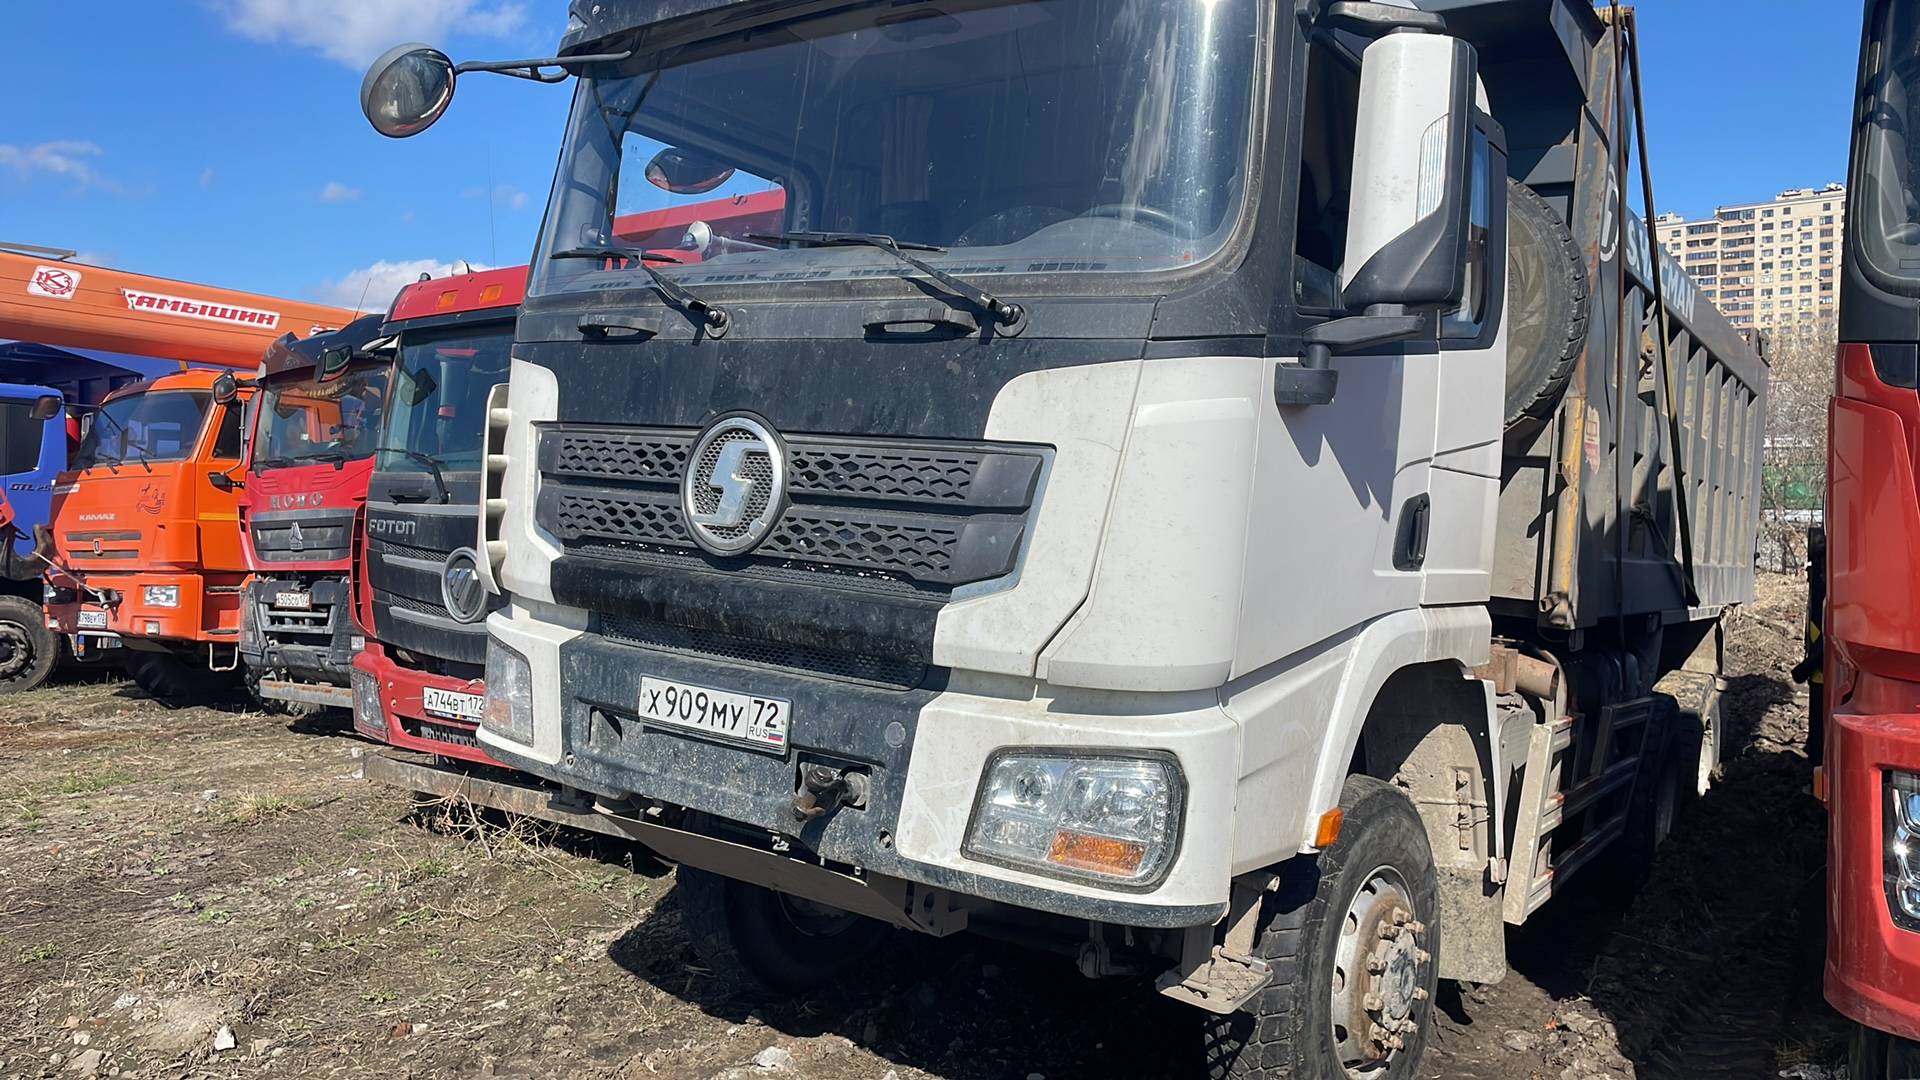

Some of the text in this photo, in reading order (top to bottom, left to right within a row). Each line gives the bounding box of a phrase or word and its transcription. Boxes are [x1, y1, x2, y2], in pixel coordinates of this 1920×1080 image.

[368, 518, 416, 535] FOTON
[427, 691, 465, 713] А744ВТ
[647, 686, 779, 730] Х909МУ 72
[749, 726, 768, 739] RUS
